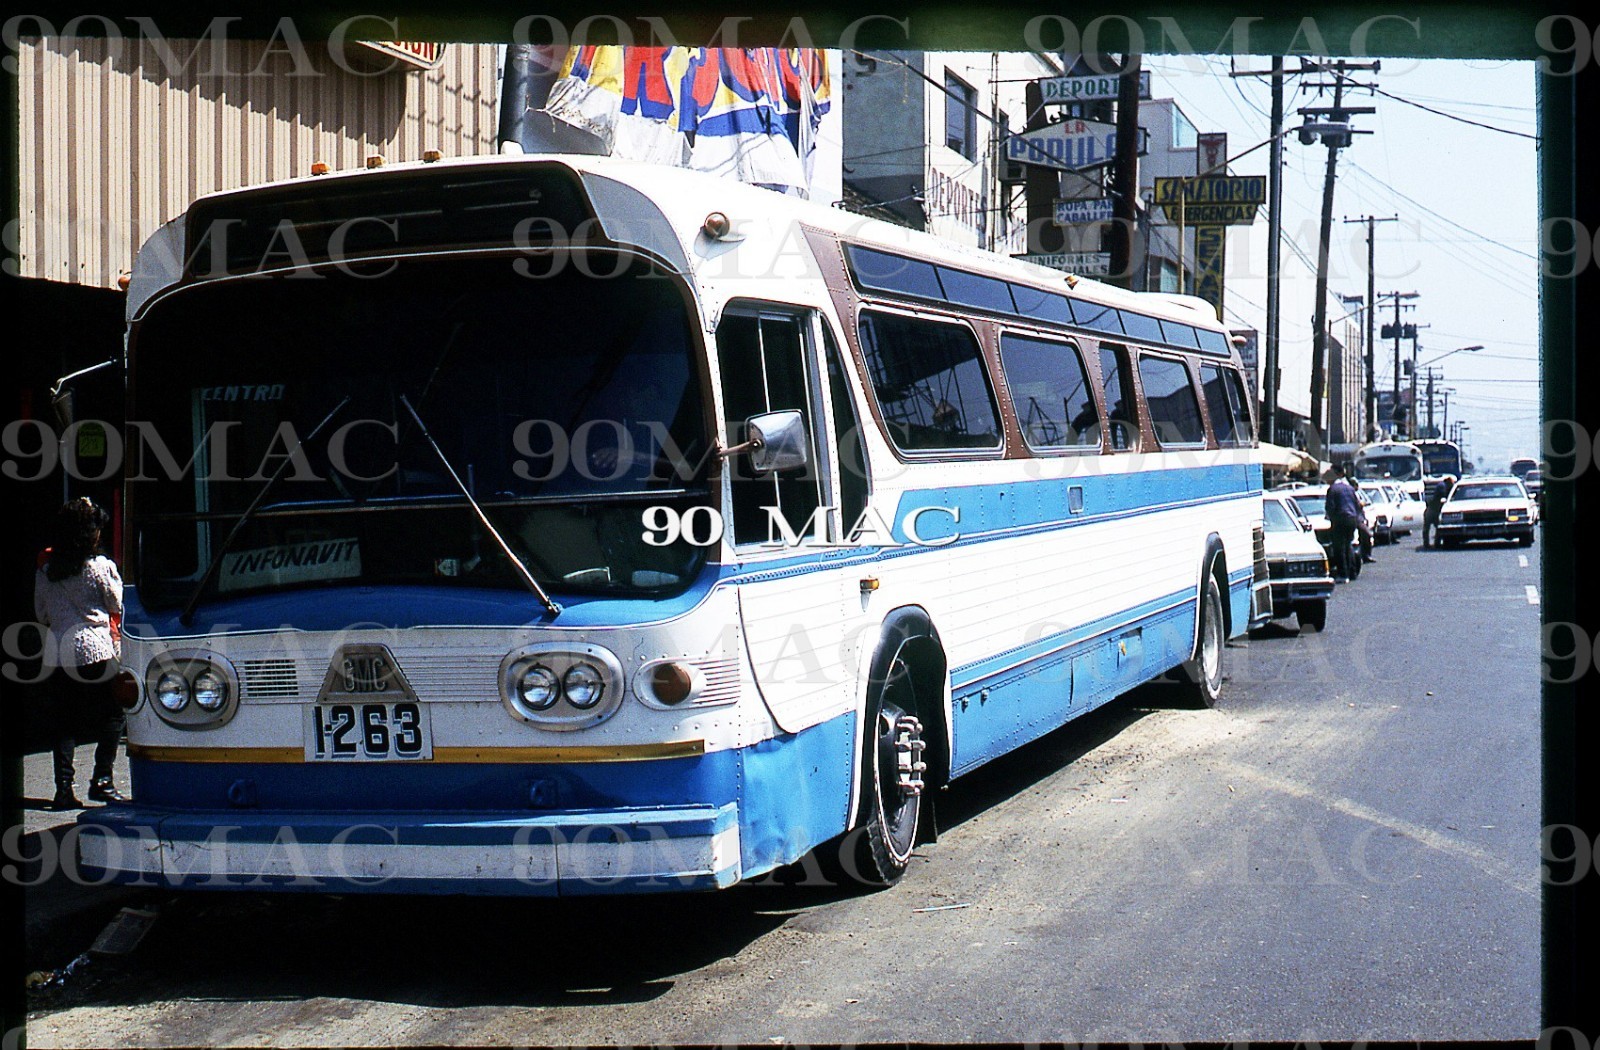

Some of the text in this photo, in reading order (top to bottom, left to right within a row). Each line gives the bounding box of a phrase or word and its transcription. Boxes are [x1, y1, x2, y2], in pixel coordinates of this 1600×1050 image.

[1046, 76, 1144, 97] DEPORTS
[1064, 121, 1085, 134] LA
[1010, 132, 1141, 168] POPULA
[1162, 178, 1262, 200] SANATORIO
[1057, 201, 1088, 211] ROPA
[201, 384, 286, 401] CENTRO
[231, 541, 358, 575] INFONAVIT
[343, 657, 387, 692] GMC
